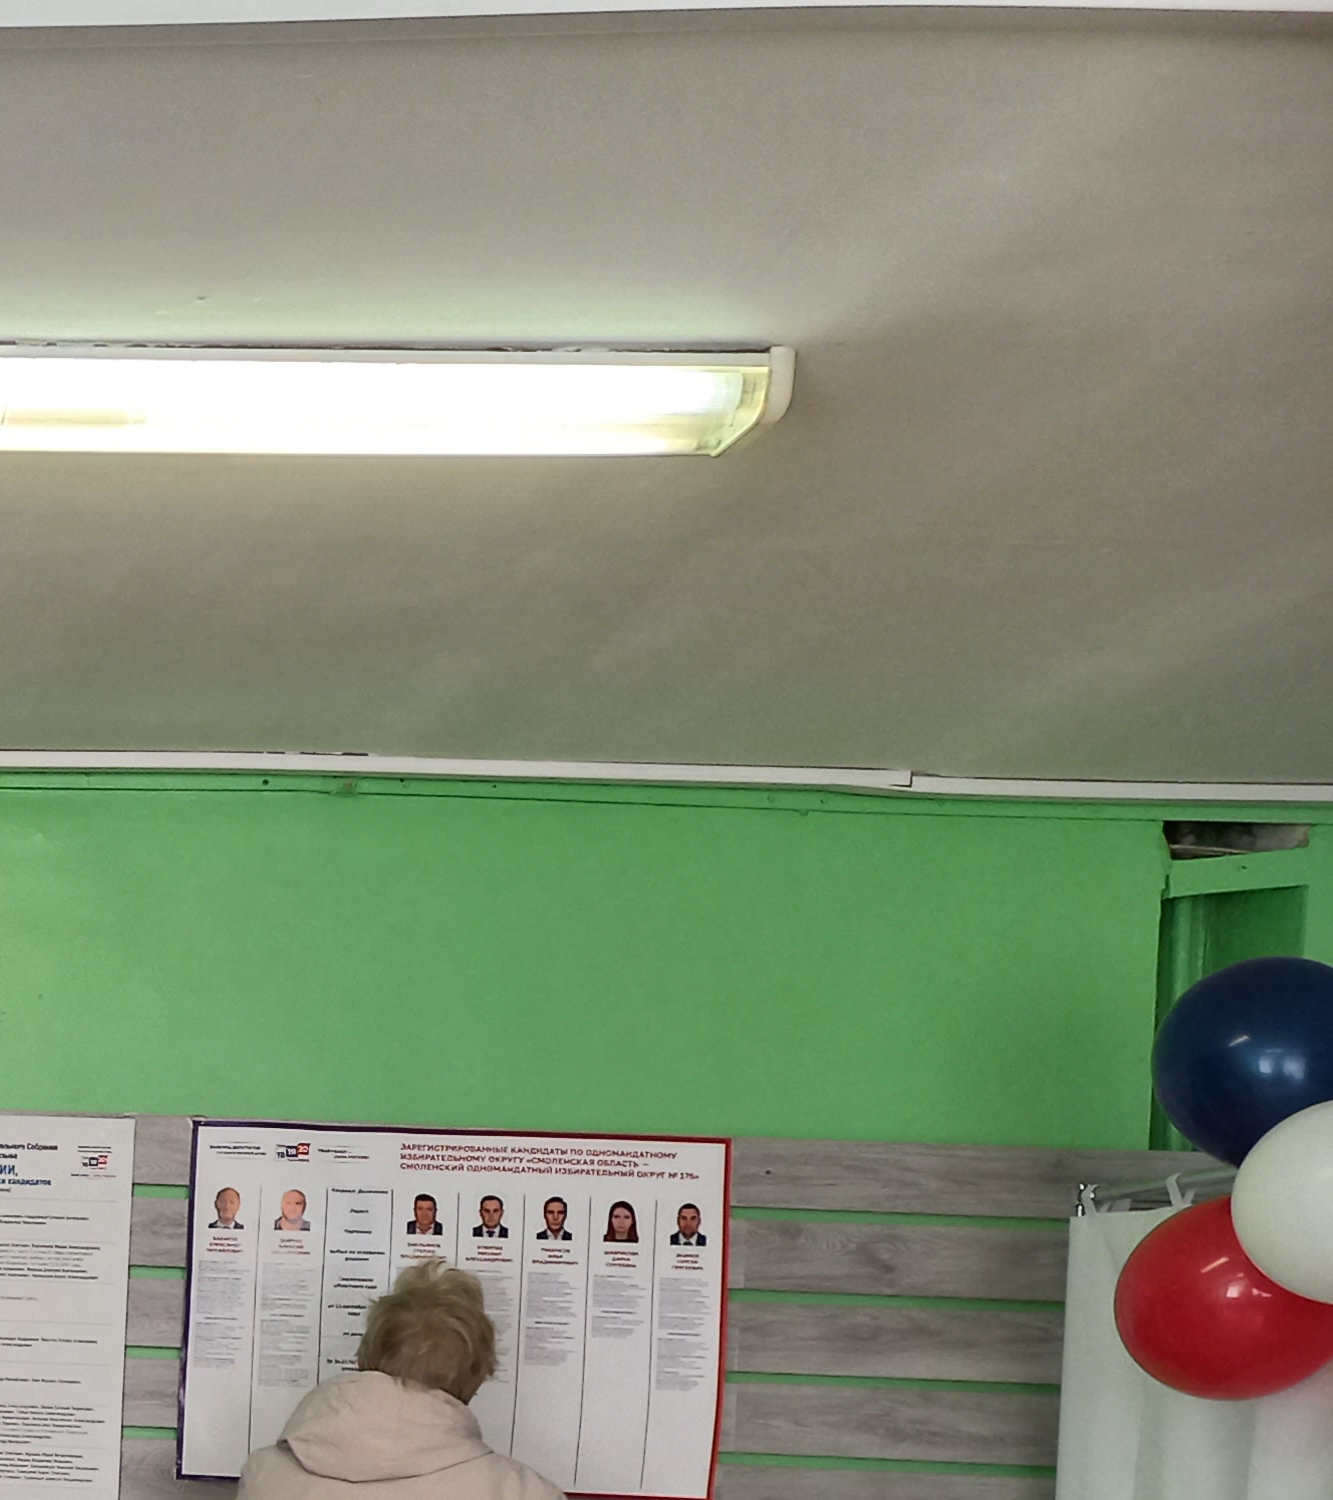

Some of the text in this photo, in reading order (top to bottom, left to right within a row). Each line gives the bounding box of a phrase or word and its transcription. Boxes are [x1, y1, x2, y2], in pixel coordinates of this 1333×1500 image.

[400, 1143, 508, 1153] ЗАРЕГИСТРИРОВАННЫЕ
[511, 1147, 568, 1156] КАНДИДАТЫ
[586, 1149, 677, 1159] ОДНОМАНДАТНОМУ
[400, 1153, 486, 1162] ИЗБИРАТЕЛЬНОМУ
[597, 1160, 639, 1168] ОБЛАСТЬ
[400, 1163, 464, 1171] СМОЛЕНСКИЙ
[467, 1165, 552, 1174] ОДНОМАНДАТНЫЙ
[555, 1168, 634, 1177] ИЗБИРАТЕЛЬНЫЙ
